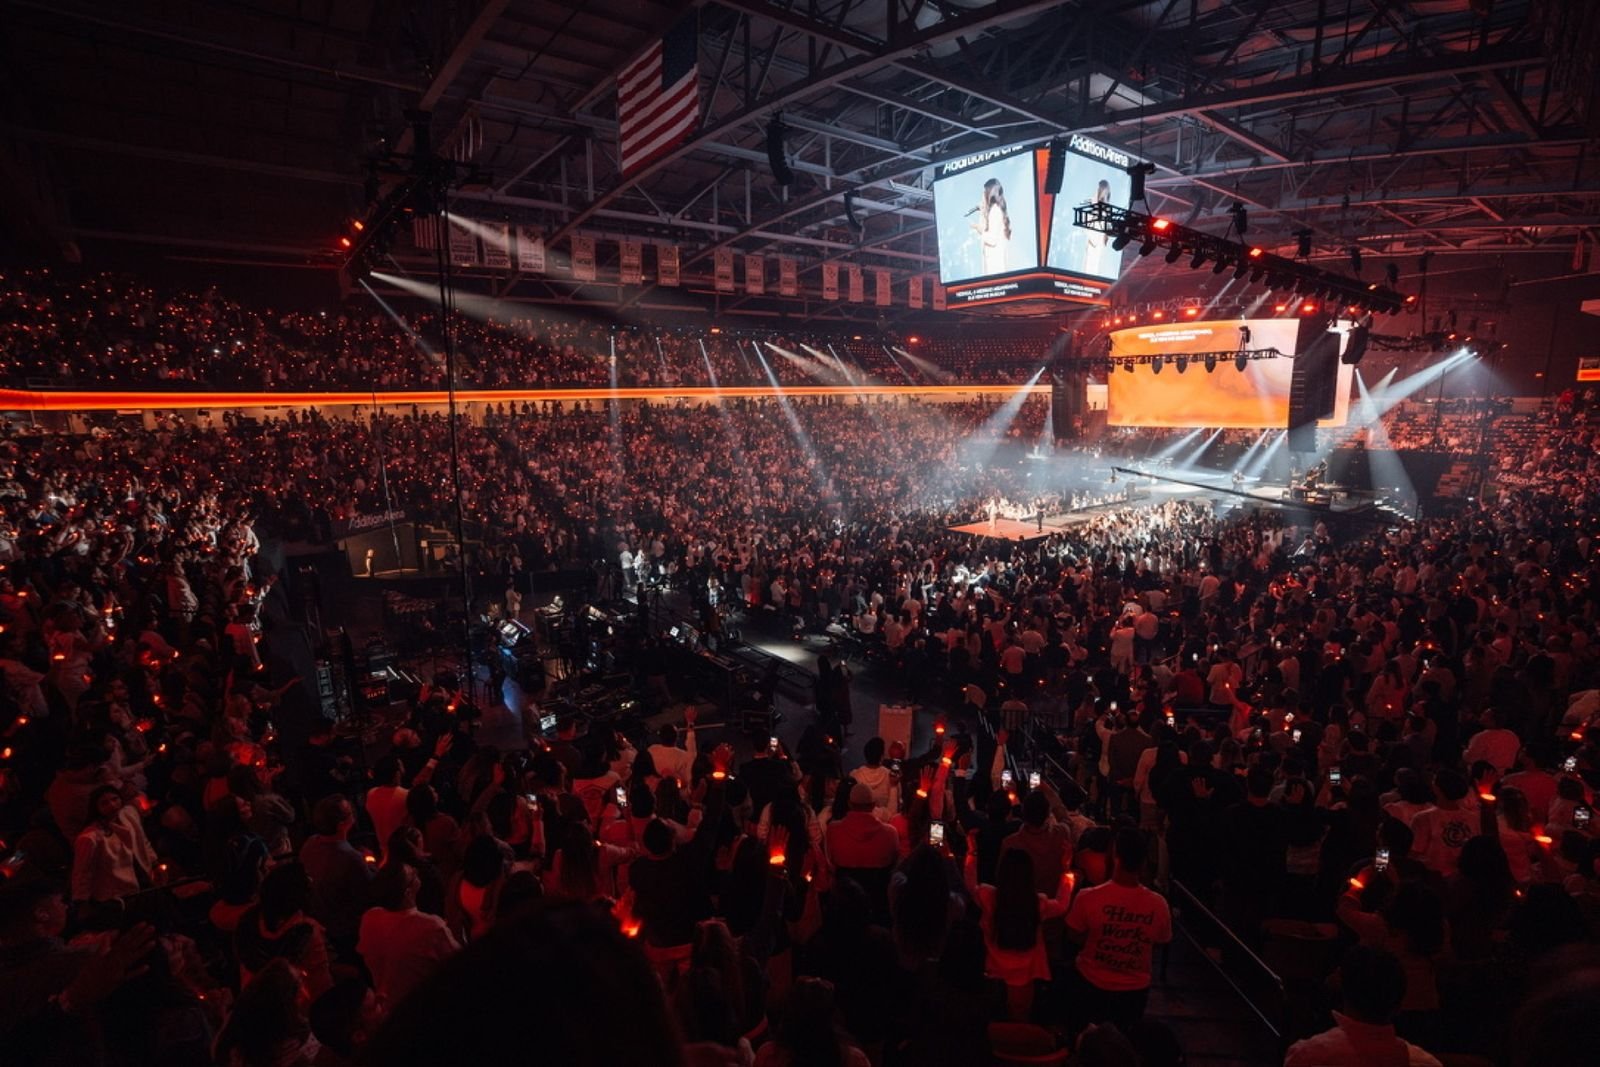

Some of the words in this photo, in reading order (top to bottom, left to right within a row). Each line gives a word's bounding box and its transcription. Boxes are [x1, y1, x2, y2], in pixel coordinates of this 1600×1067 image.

[1069, 134, 1105, 158] Addition
[1105, 148, 1129, 167] Arena
[1103, 904, 1155, 925] Hard
